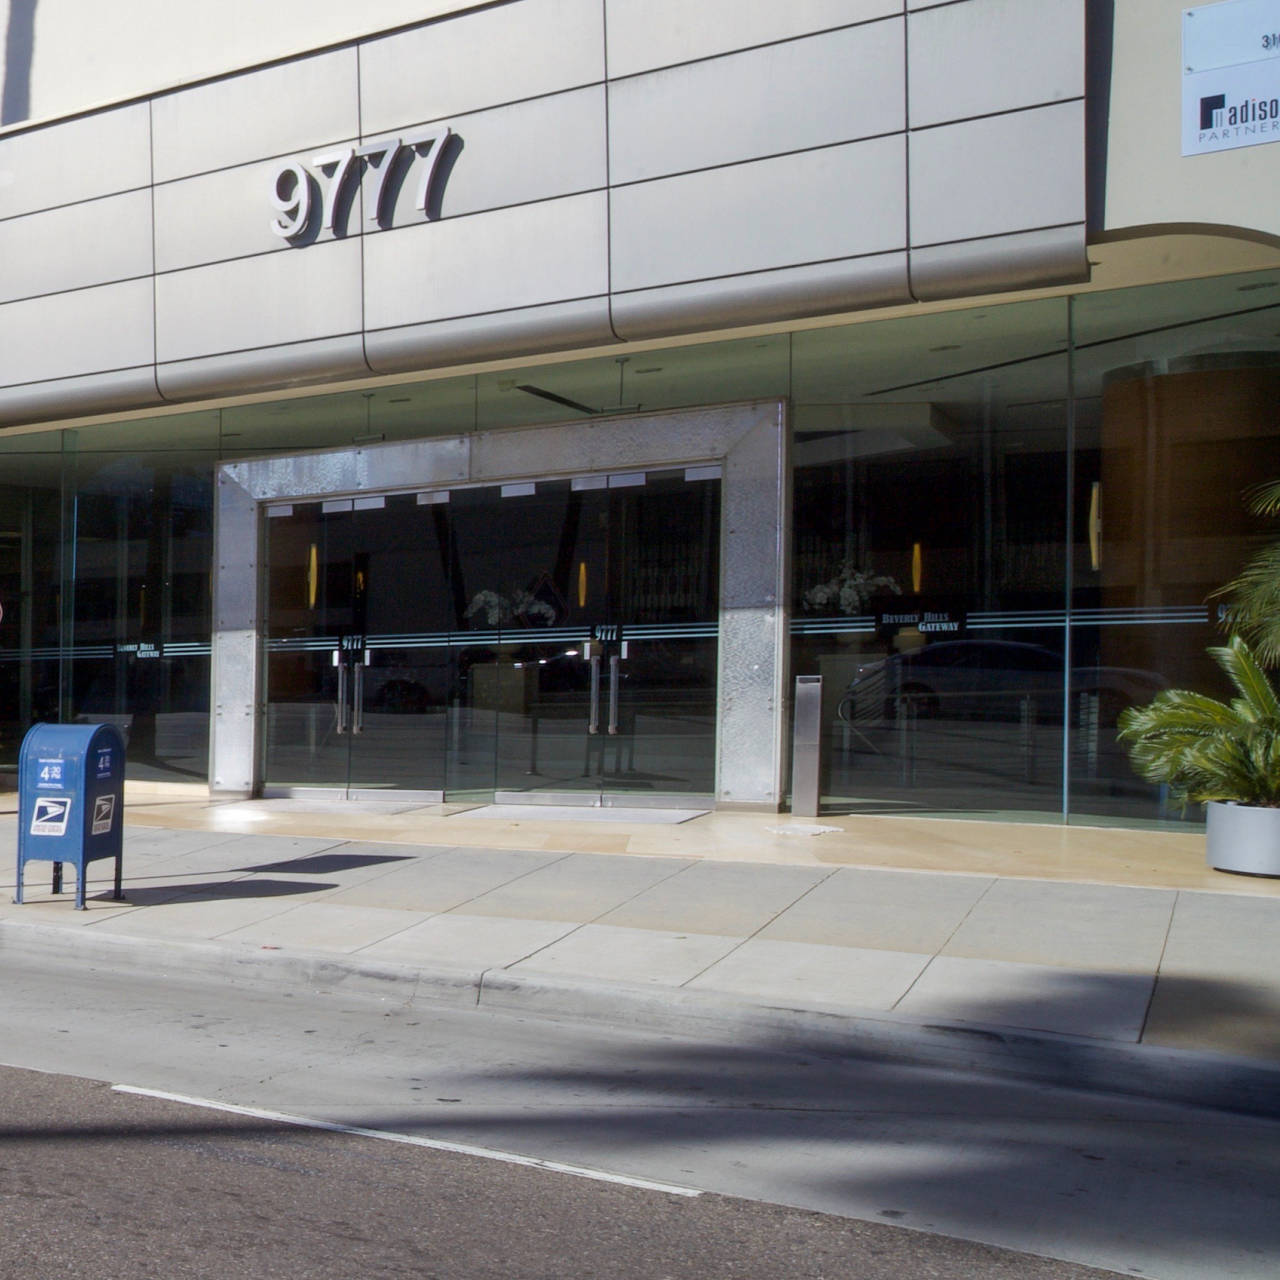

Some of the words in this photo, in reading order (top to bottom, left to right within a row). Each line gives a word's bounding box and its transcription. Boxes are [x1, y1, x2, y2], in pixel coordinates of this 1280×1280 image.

[1261, 32, 1280, 51] 31
[270, 126, 453, 240] 9777
[595, 624, 617, 641] 9777
[342, 635, 363, 650] 9777
